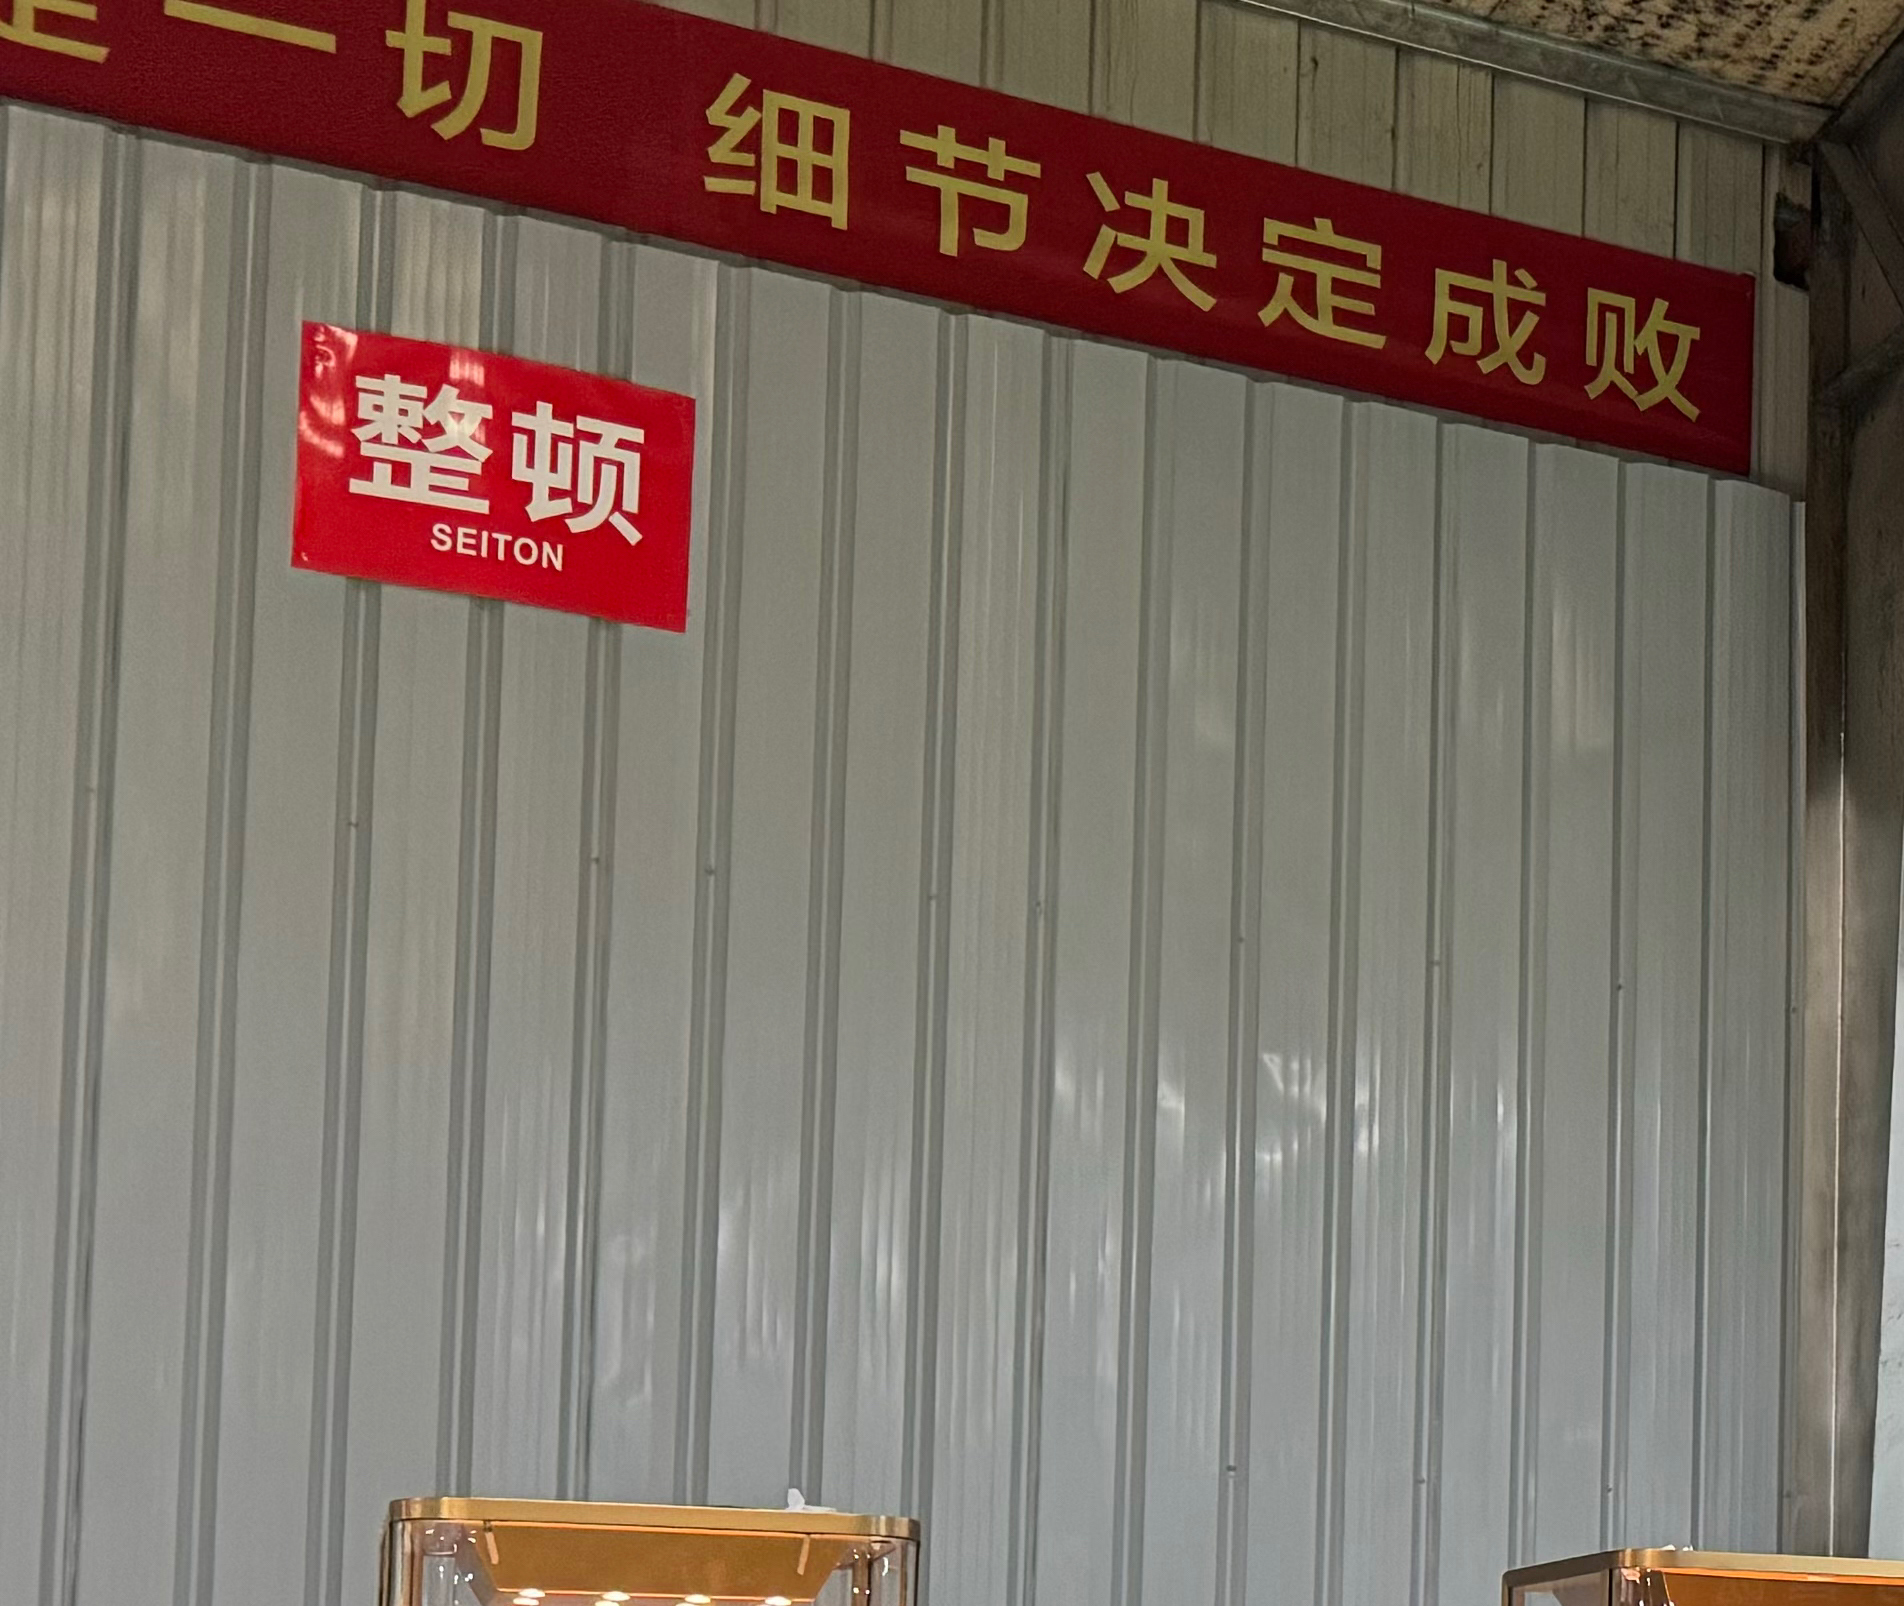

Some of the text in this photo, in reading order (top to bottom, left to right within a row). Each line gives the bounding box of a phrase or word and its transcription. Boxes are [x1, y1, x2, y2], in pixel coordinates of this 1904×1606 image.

[704, 74, 1700, 422] 细节决定成败
[349, 373, 645, 546] 整顿
[430, 522, 564, 572] SEITON
